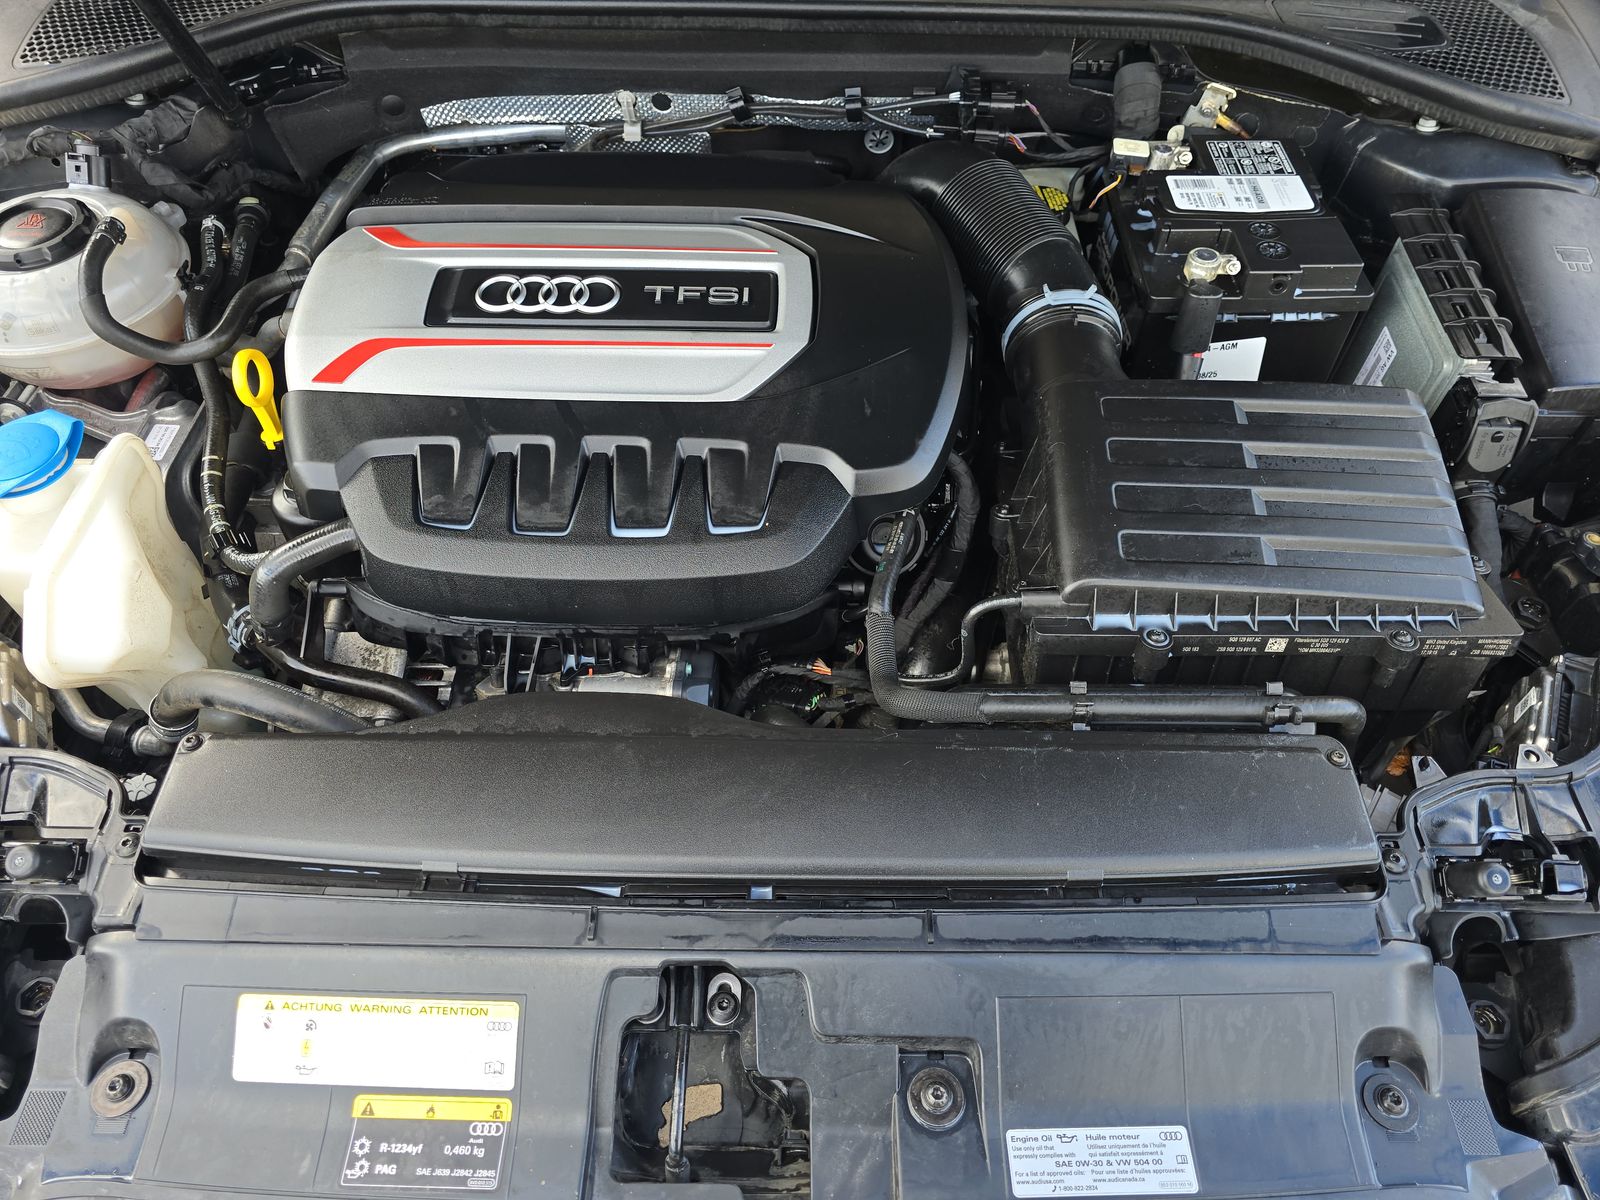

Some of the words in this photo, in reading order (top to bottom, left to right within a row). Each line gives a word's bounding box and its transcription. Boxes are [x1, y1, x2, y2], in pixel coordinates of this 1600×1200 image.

[644, 286, 750, 305] TFSI
[282, 1002, 342, 1012] ACHTUNG
[350, 1003, 412, 1015] WARNING
[418, 1006, 489, 1016] ATTENTION
[1010, 1136, 1038, 1144] Engine
[380, 1143, 423, 1155] R-1234yf
[444, 1146, 471, 1156] 0,460
[472, 1146, 485, 1158] kg
[375, 1164, 397, 1175] PAG
[416, 1168, 431, 1176] SAE
[433, 1168, 450, 1176] J639
[451, 1168, 472, 1177] J2842
